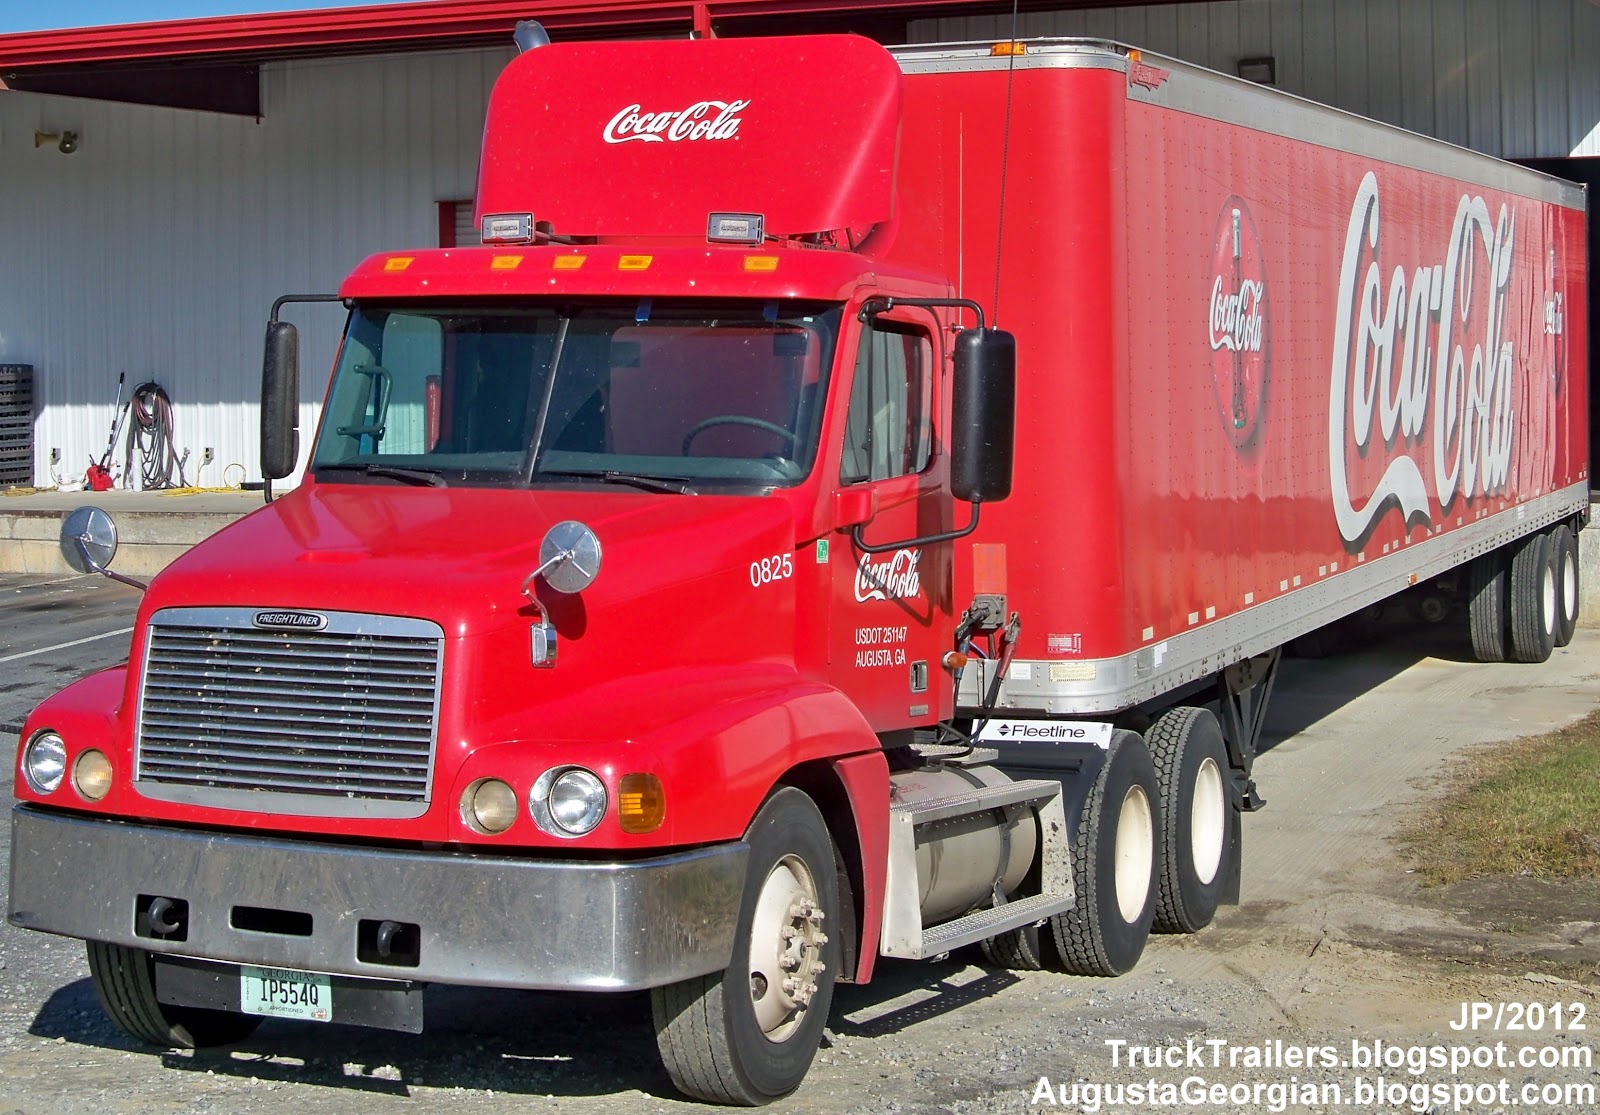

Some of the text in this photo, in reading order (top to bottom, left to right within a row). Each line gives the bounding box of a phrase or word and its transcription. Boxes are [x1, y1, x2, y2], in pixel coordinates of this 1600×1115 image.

[603, 99, 751, 144] Coca-Cola
[1209, 274, 1263, 352] Coca-Cola
[1330, 171, 1516, 541] Coca-Cola
[750, 553, 793, 587] 0825
[854, 549, 922, 603] Coca-Cola
[258, 613, 319, 625] FREIGHTLINER
[855, 626, 907, 645] USDOT 251147
[855, 649, 906, 668] AUGUSTA, GA
[1011, 725, 1086, 738] Fleetline
[260, 978, 319, 1007] IP554Q
[269, 1005, 304, 1014] APPORTIONED
